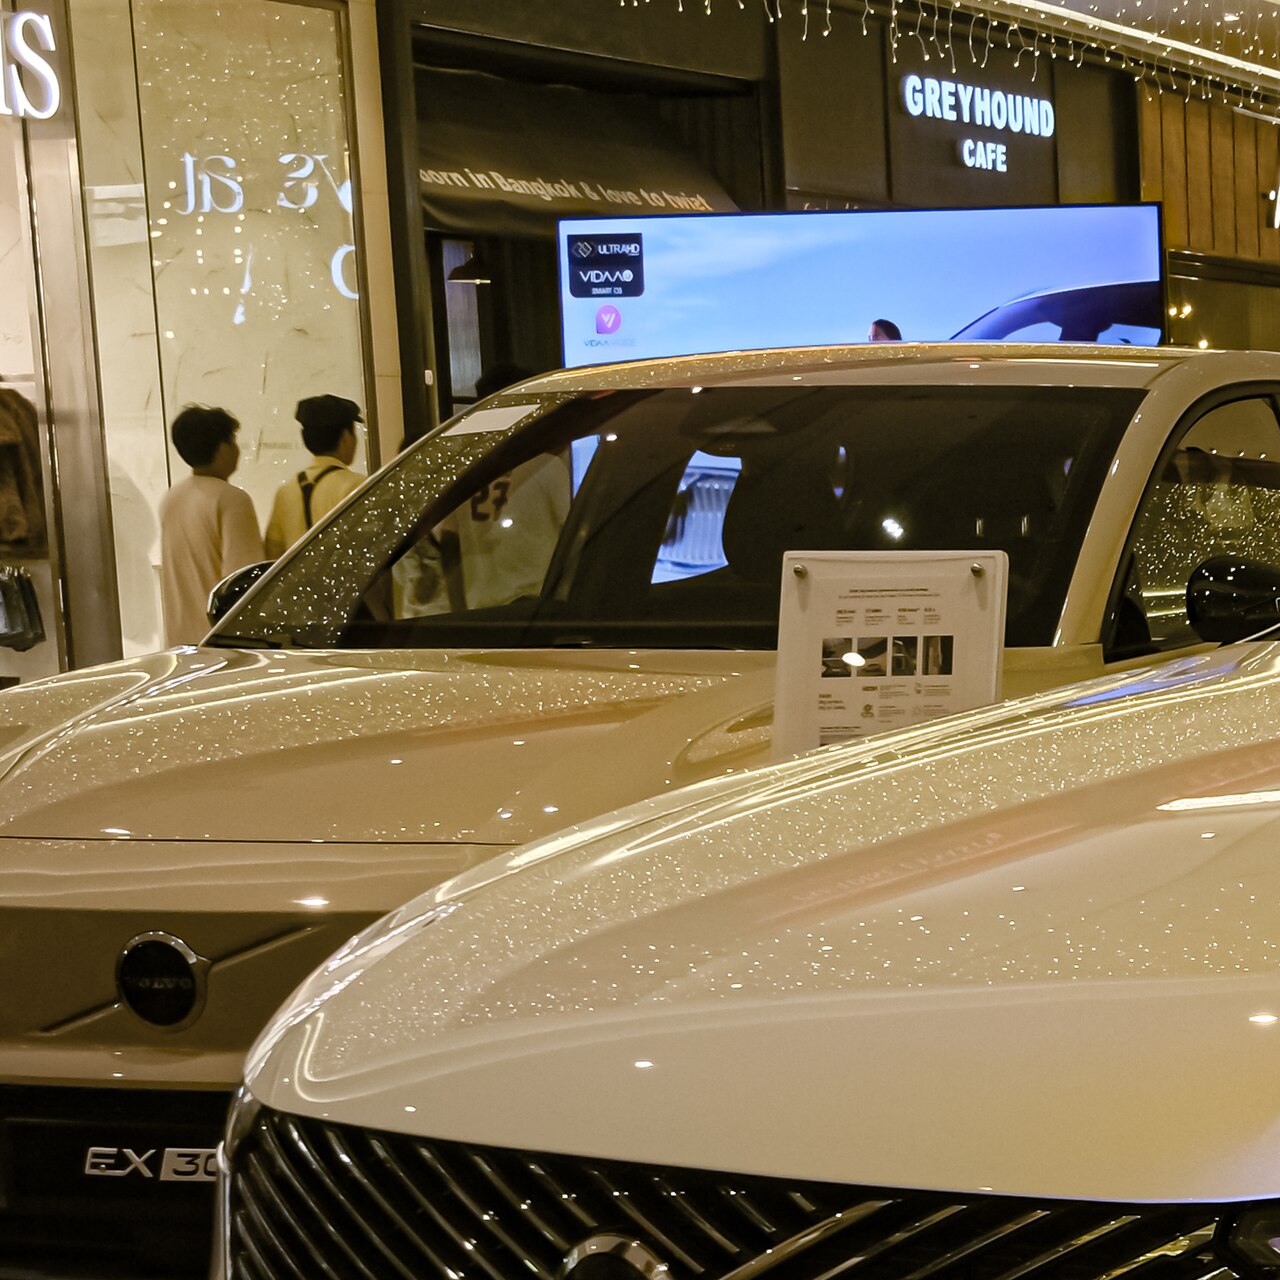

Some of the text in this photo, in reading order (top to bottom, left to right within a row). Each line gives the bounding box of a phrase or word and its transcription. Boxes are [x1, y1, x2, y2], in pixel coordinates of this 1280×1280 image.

[905, 75, 1055, 137] GREYHOUND
[962, 139, 1008, 173] CAFE
[464, 168, 495, 189] in
[490, 171, 583, 201] Bangkok
[579, 181, 601, 201] &
[598, 183, 643, 206] love
[640, 188, 666, 207] to
